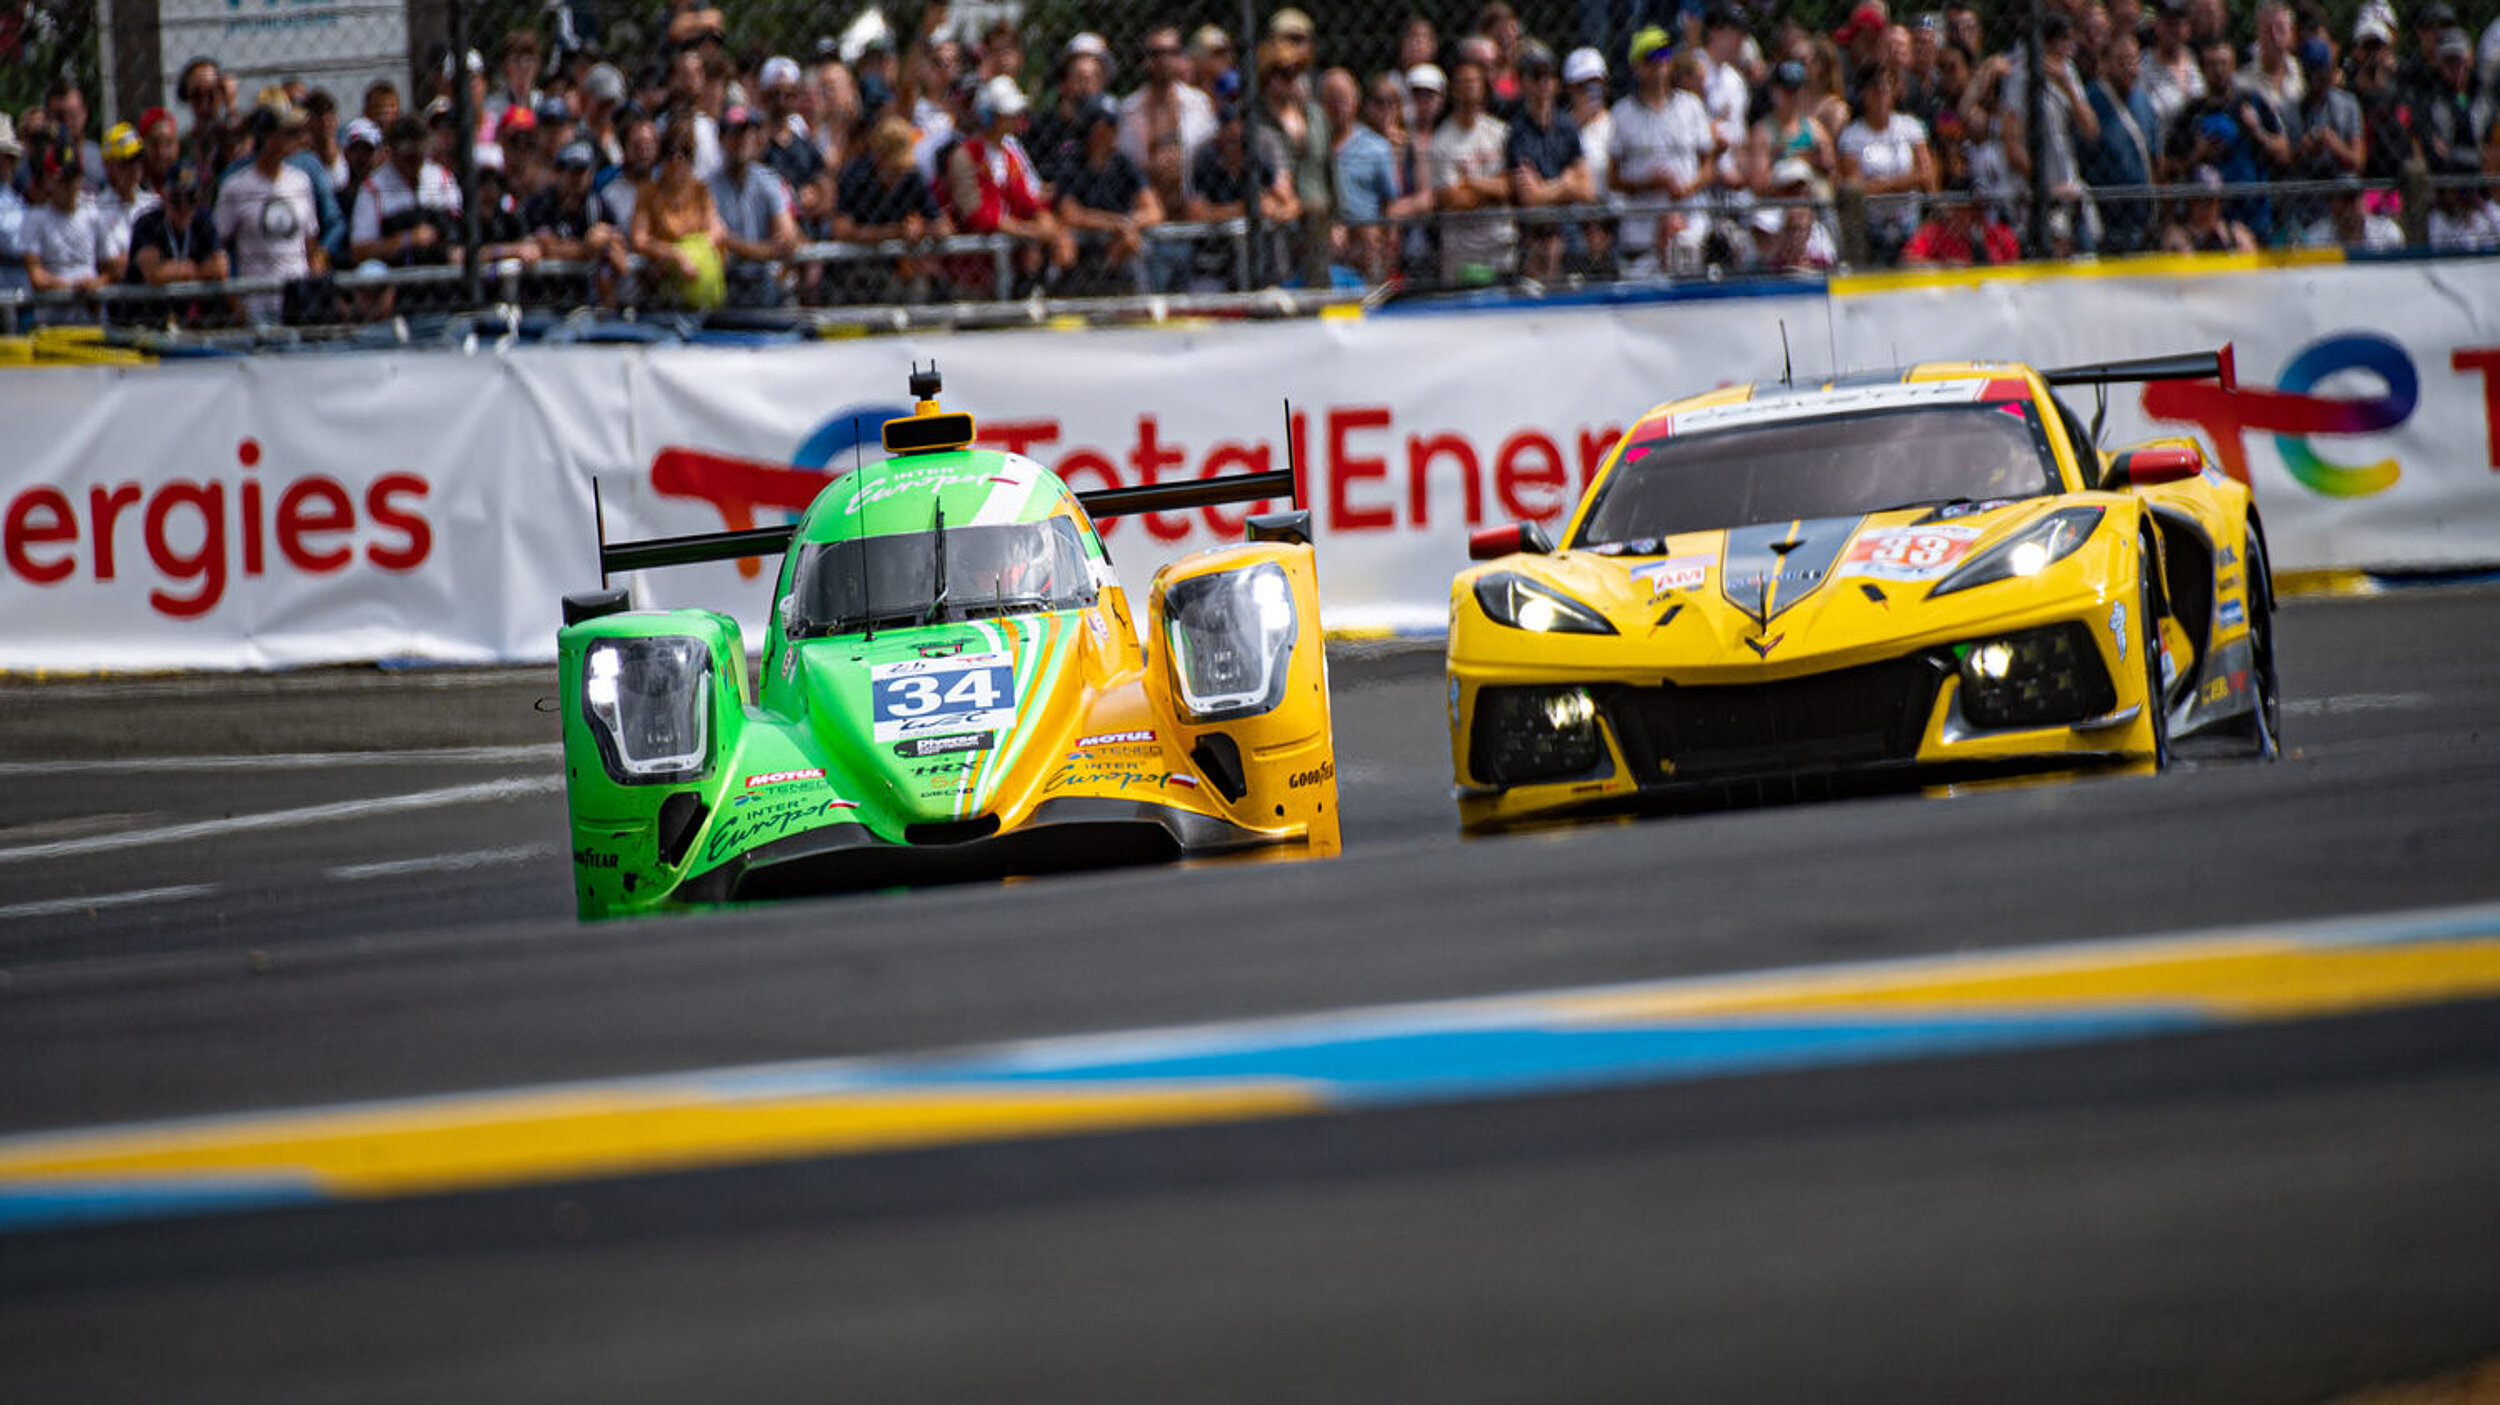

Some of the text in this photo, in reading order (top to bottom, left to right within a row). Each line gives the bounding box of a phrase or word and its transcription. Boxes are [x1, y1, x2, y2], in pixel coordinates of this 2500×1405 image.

[844, 472, 991, 515] Europol
[3, 437, 433, 619] ergies
[1656, 568, 1701, 590] AM
[887, 669, 1001, 717] 34
[1078, 730, 1156, 747] MOTUL
[748, 768, 824, 788] MOTUL
[1041, 763, 1173, 794] Europol
[1085, 761, 1139, 770] INTER
[747, 800, 799, 820] INTER
[706, 799, 833, 863] Europol
